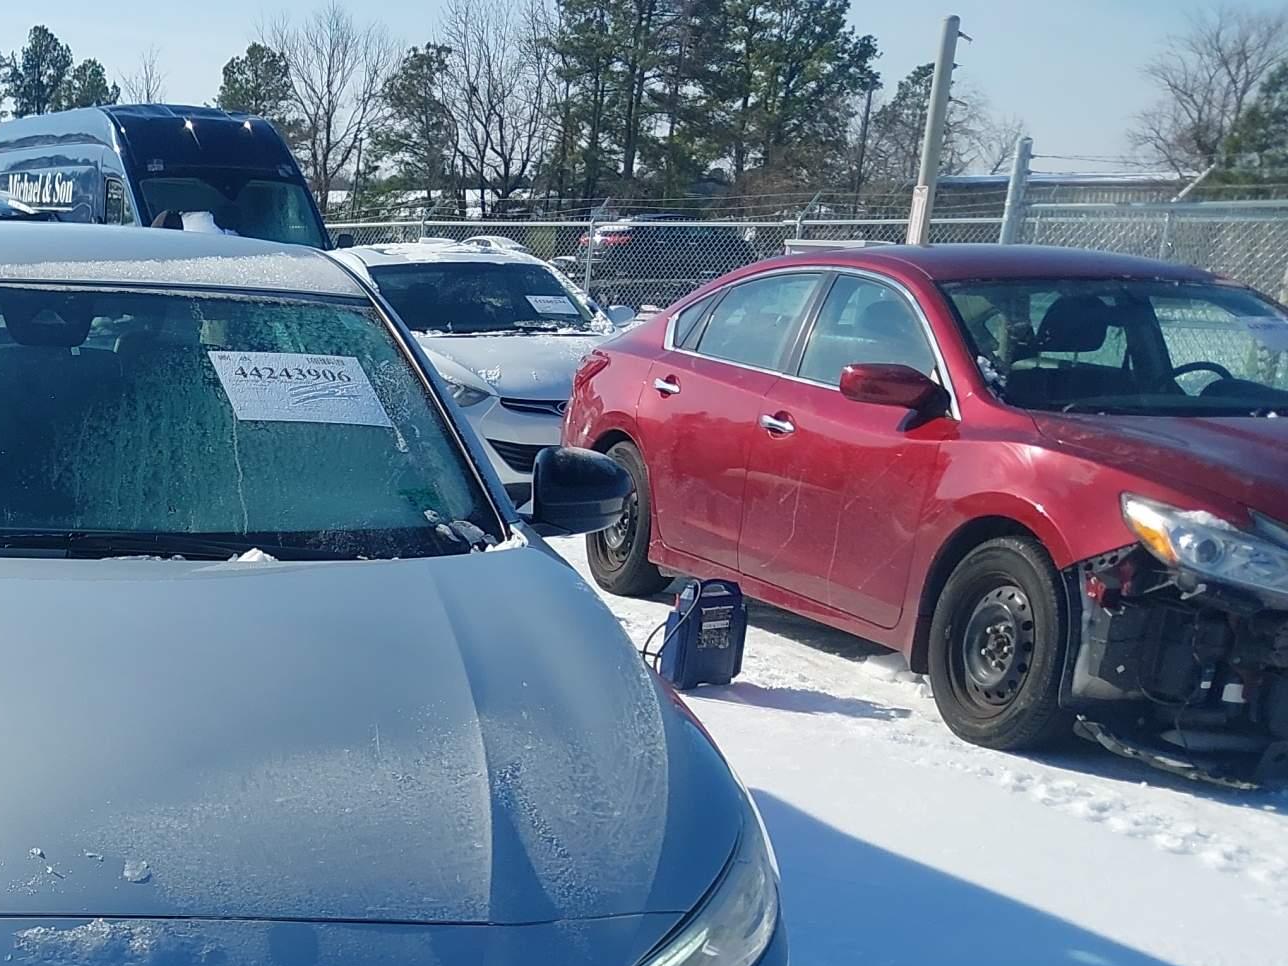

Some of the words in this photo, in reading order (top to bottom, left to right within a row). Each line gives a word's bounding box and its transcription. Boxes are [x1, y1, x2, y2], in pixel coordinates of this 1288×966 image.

[8, 173, 42, 202] Michael
[42, 172, 53, 203] &
[53, 172, 73, 203] Son
[234, 365, 351, 382] 44243906
